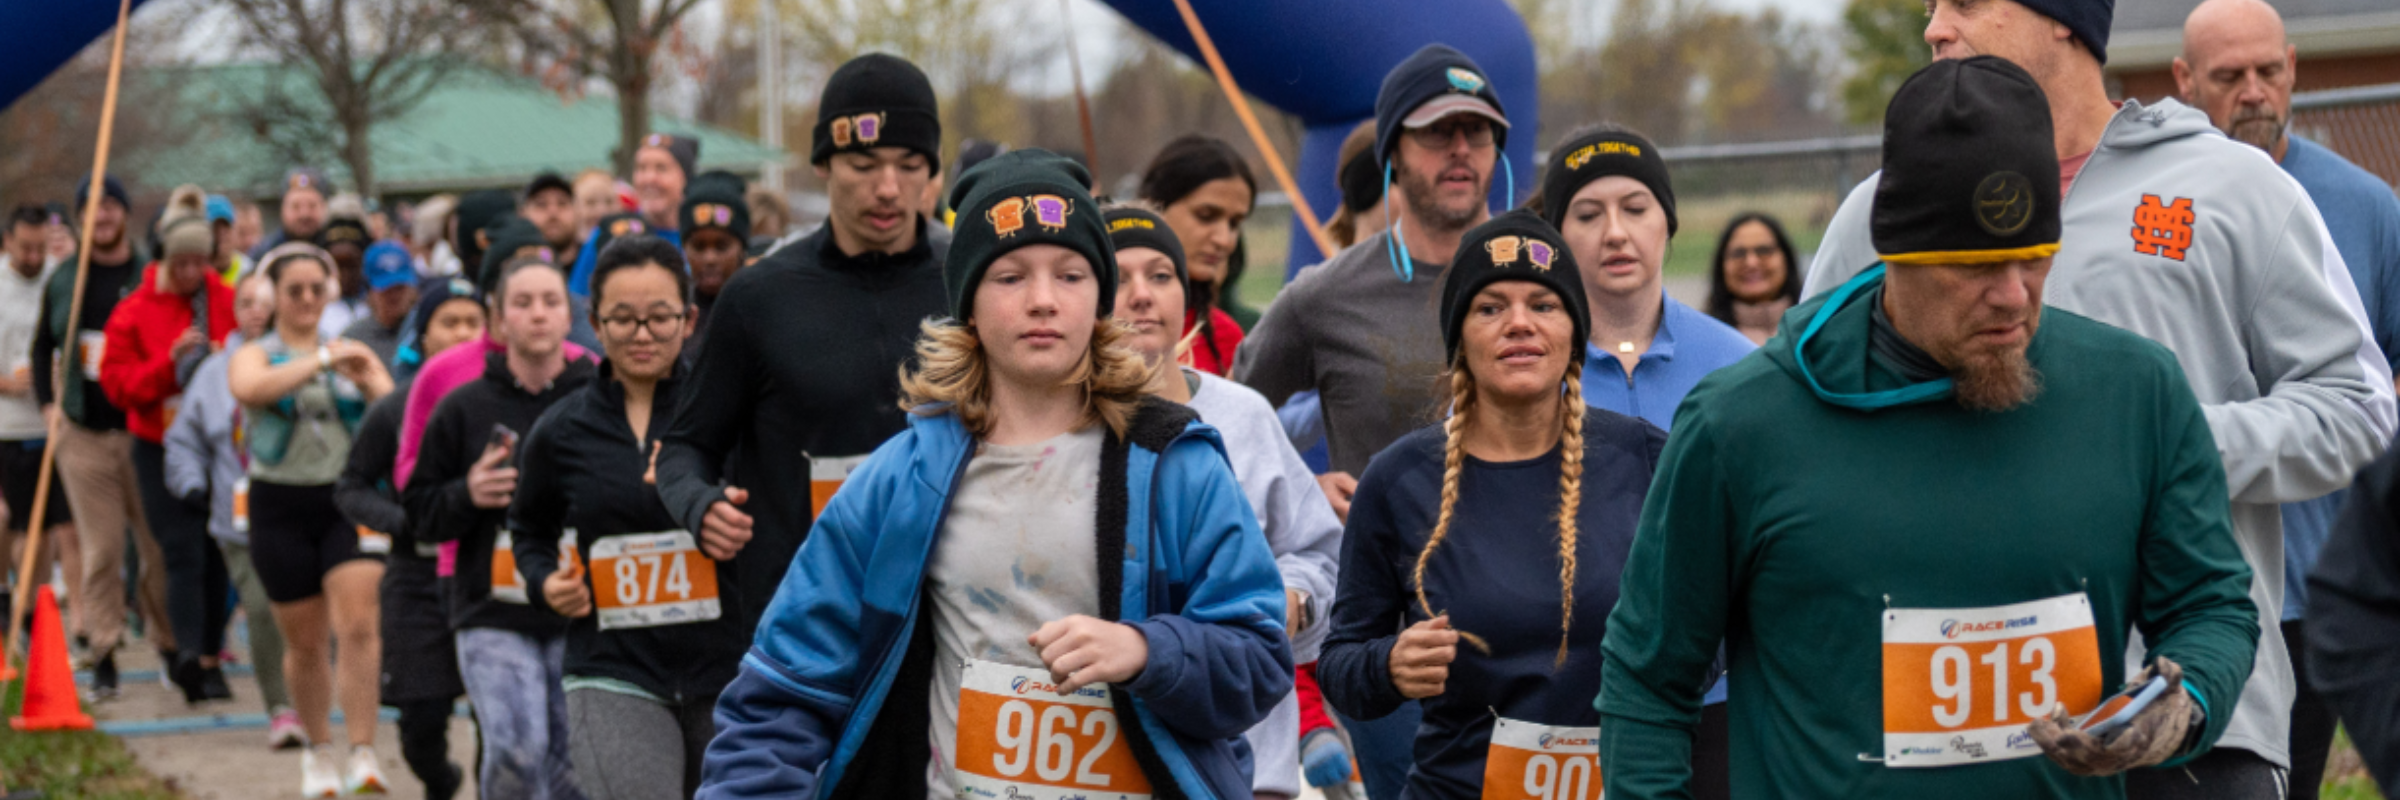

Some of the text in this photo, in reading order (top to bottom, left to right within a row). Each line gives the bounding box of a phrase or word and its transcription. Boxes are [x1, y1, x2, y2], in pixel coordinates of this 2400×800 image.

[615, 553, 692, 605] 874
[1961, 615, 2038, 632] RACERISE
[1930, 636, 2057, 728] 913
[993, 699, 1119, 787] 962
[1524, 754, 1605, 800] 90
